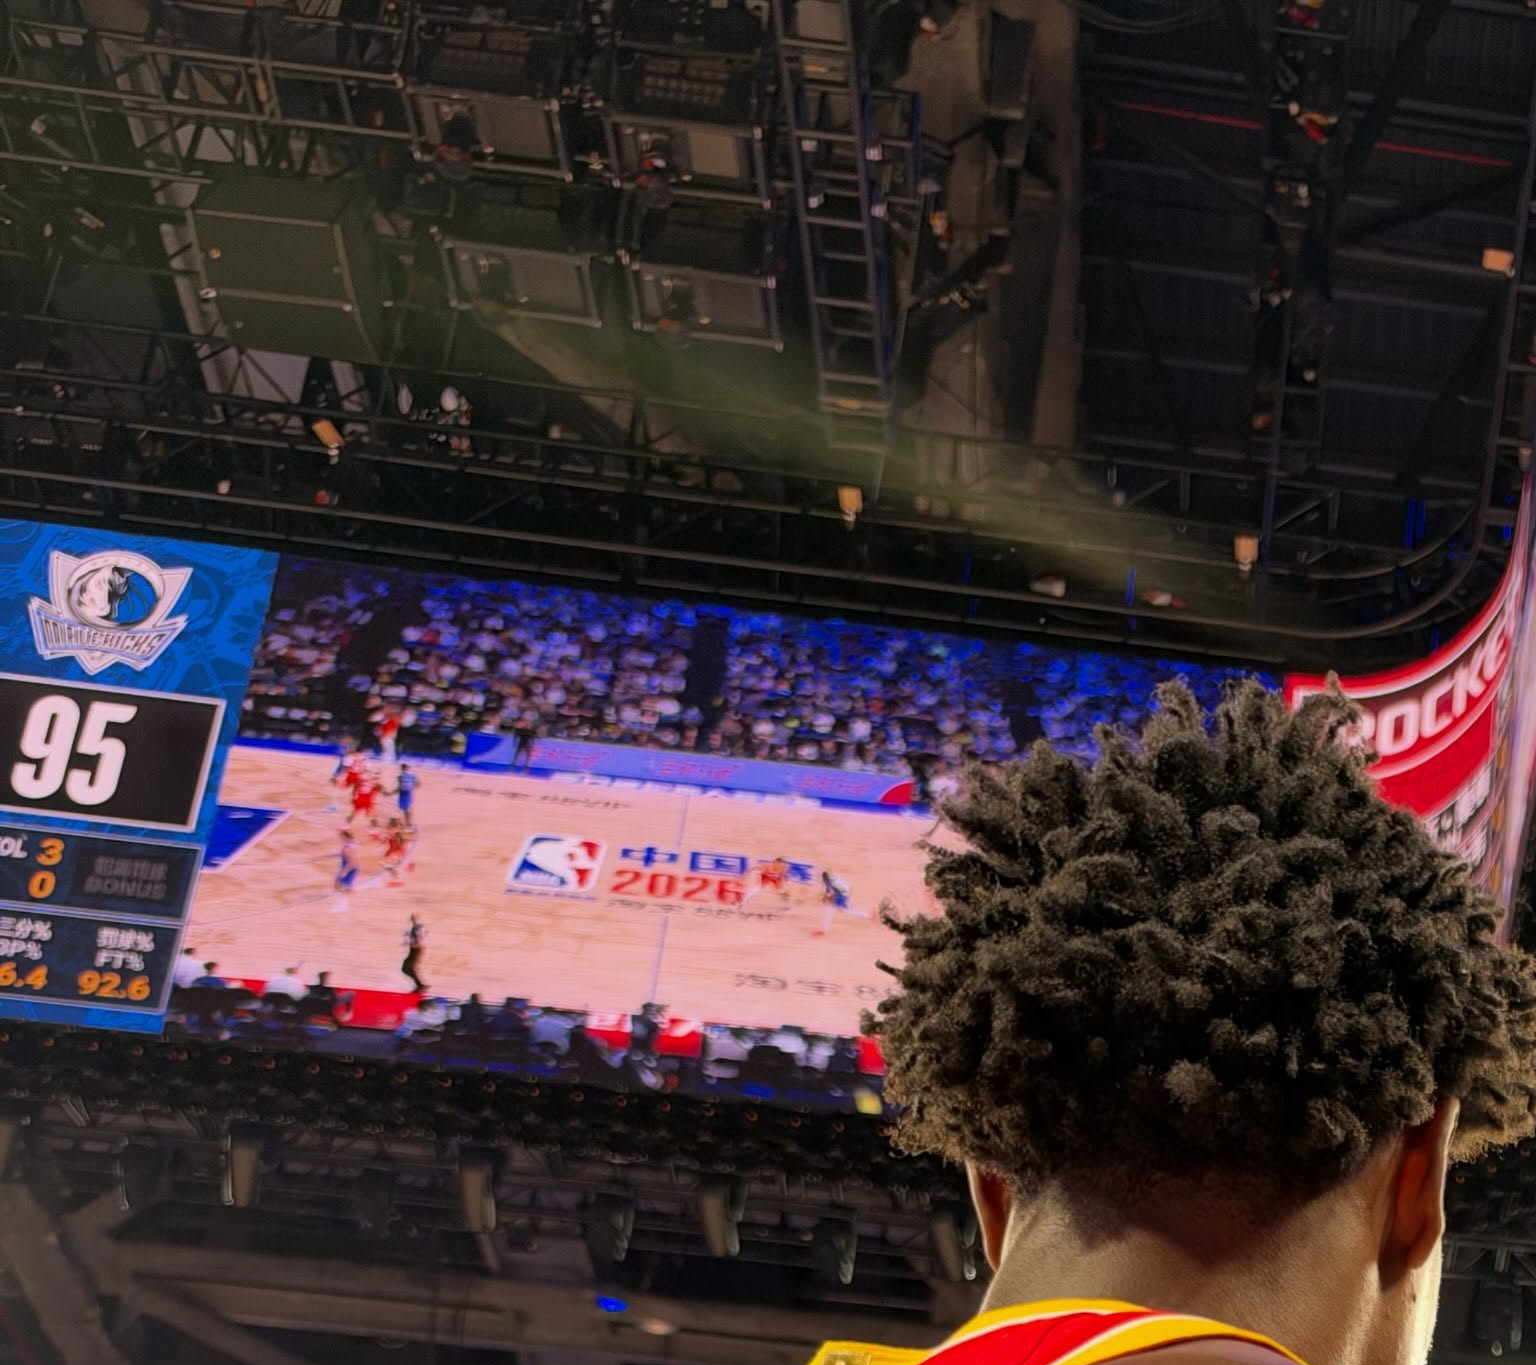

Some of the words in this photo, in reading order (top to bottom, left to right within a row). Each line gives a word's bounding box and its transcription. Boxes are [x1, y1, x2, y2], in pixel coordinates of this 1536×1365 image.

[43, 617, 164, 656] MAVERICKS
[10, 695, 138, 806] 95
[0, 836, 28, 858] OL
[35, 837, 65, 866] 3
[27, 870, 56, 899] 0
[610, 869, 746, 906] 2026
[76, 969, 151, 1001] 92.6
